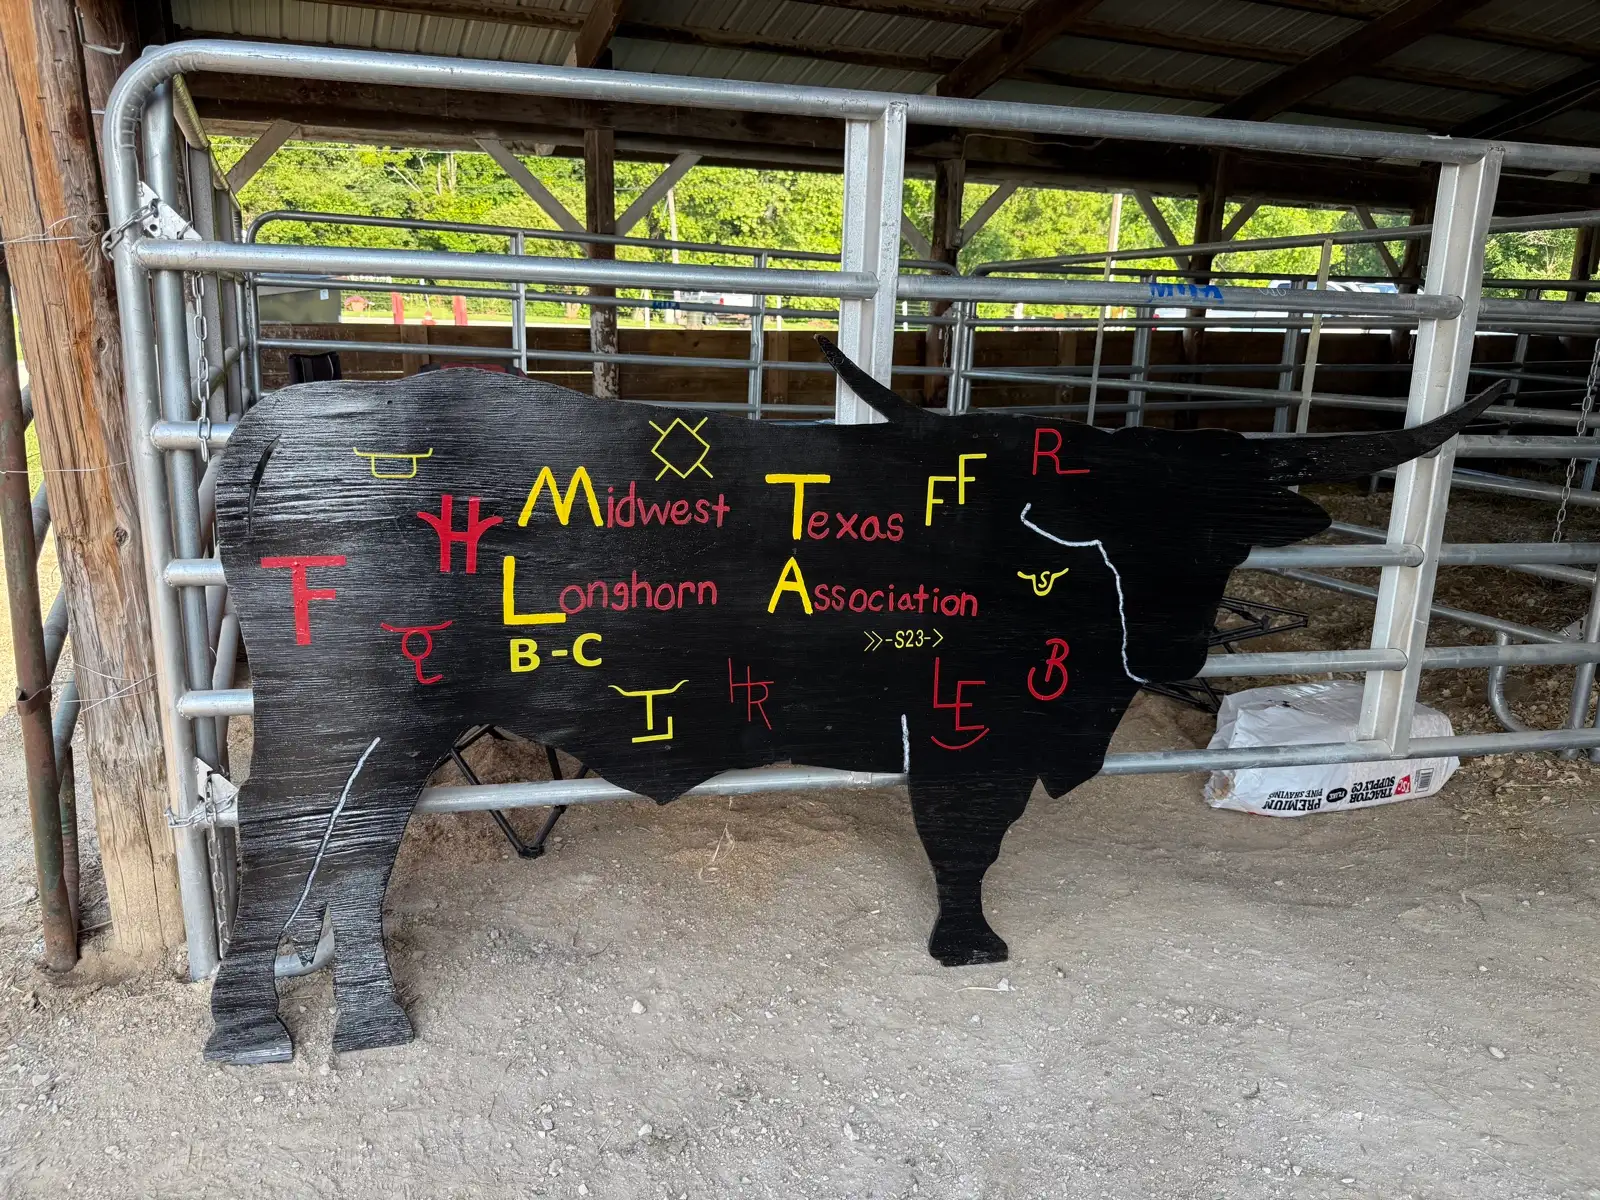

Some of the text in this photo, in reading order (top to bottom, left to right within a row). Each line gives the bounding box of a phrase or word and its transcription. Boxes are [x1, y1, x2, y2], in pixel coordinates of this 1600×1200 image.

[517, 466, 904, 541] Midwest Texas
[503, 555, 978, 626] Longhorn Association
[1362, 776, 1395, 790] SUPPLY
[1304, 788, 1323, 798] PINE
[1349, 787, 1393, 804] TRACTOR
